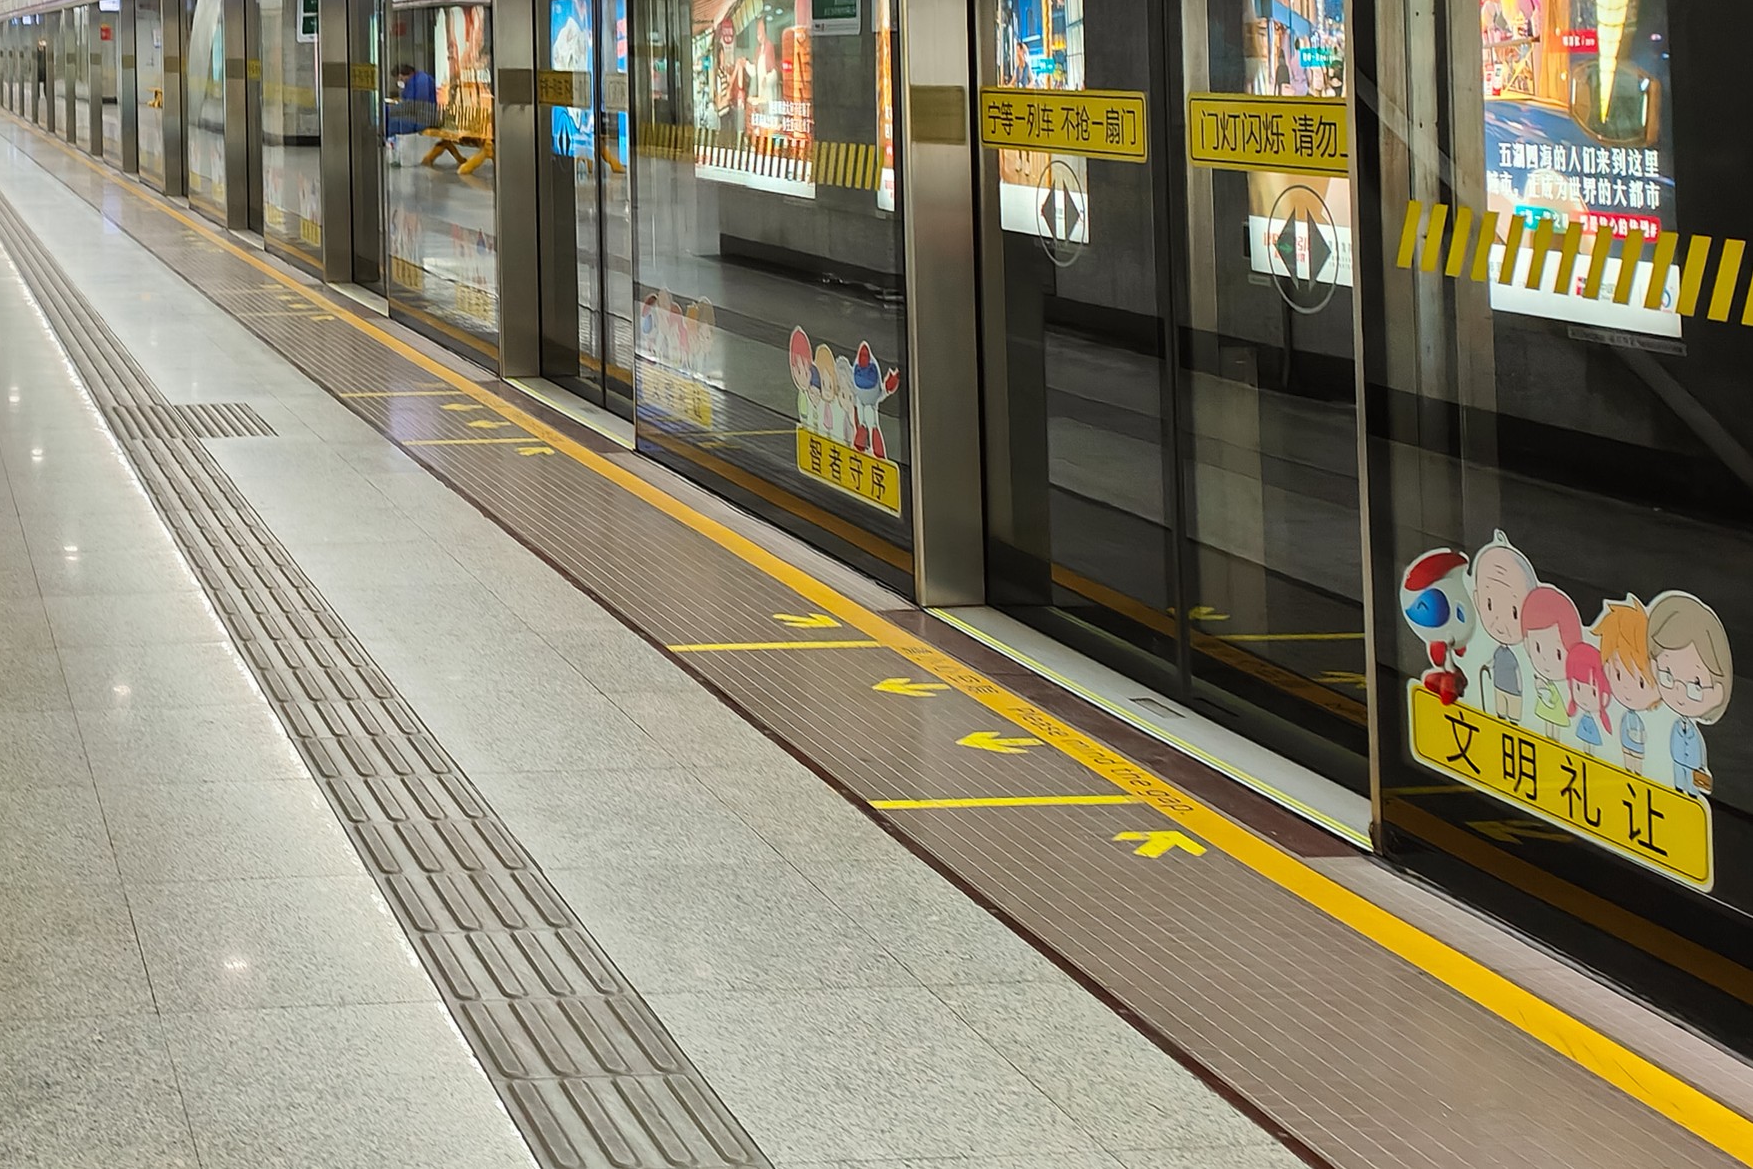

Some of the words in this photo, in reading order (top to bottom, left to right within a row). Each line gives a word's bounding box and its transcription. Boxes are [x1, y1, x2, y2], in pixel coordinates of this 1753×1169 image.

[988, 101, 1054, 138] 宁等一列车
[1061, 105, 1136, 145] 不抢一扇门
[1201, 110, 1285, 154] 门灯闪烁
[1292, 114, 1348, 158] 请勿
[1498, 142, 1660, 178] 五湖四海的人们来到这里
[1008, 705, 1069, 737] Please
[1062, 737, 1116, 765] mind
[1111, 761, 1151, 788] the
[1137, 789, 1194, 816] gap.
[1444, 711, 1668, 857] 文明礼让
